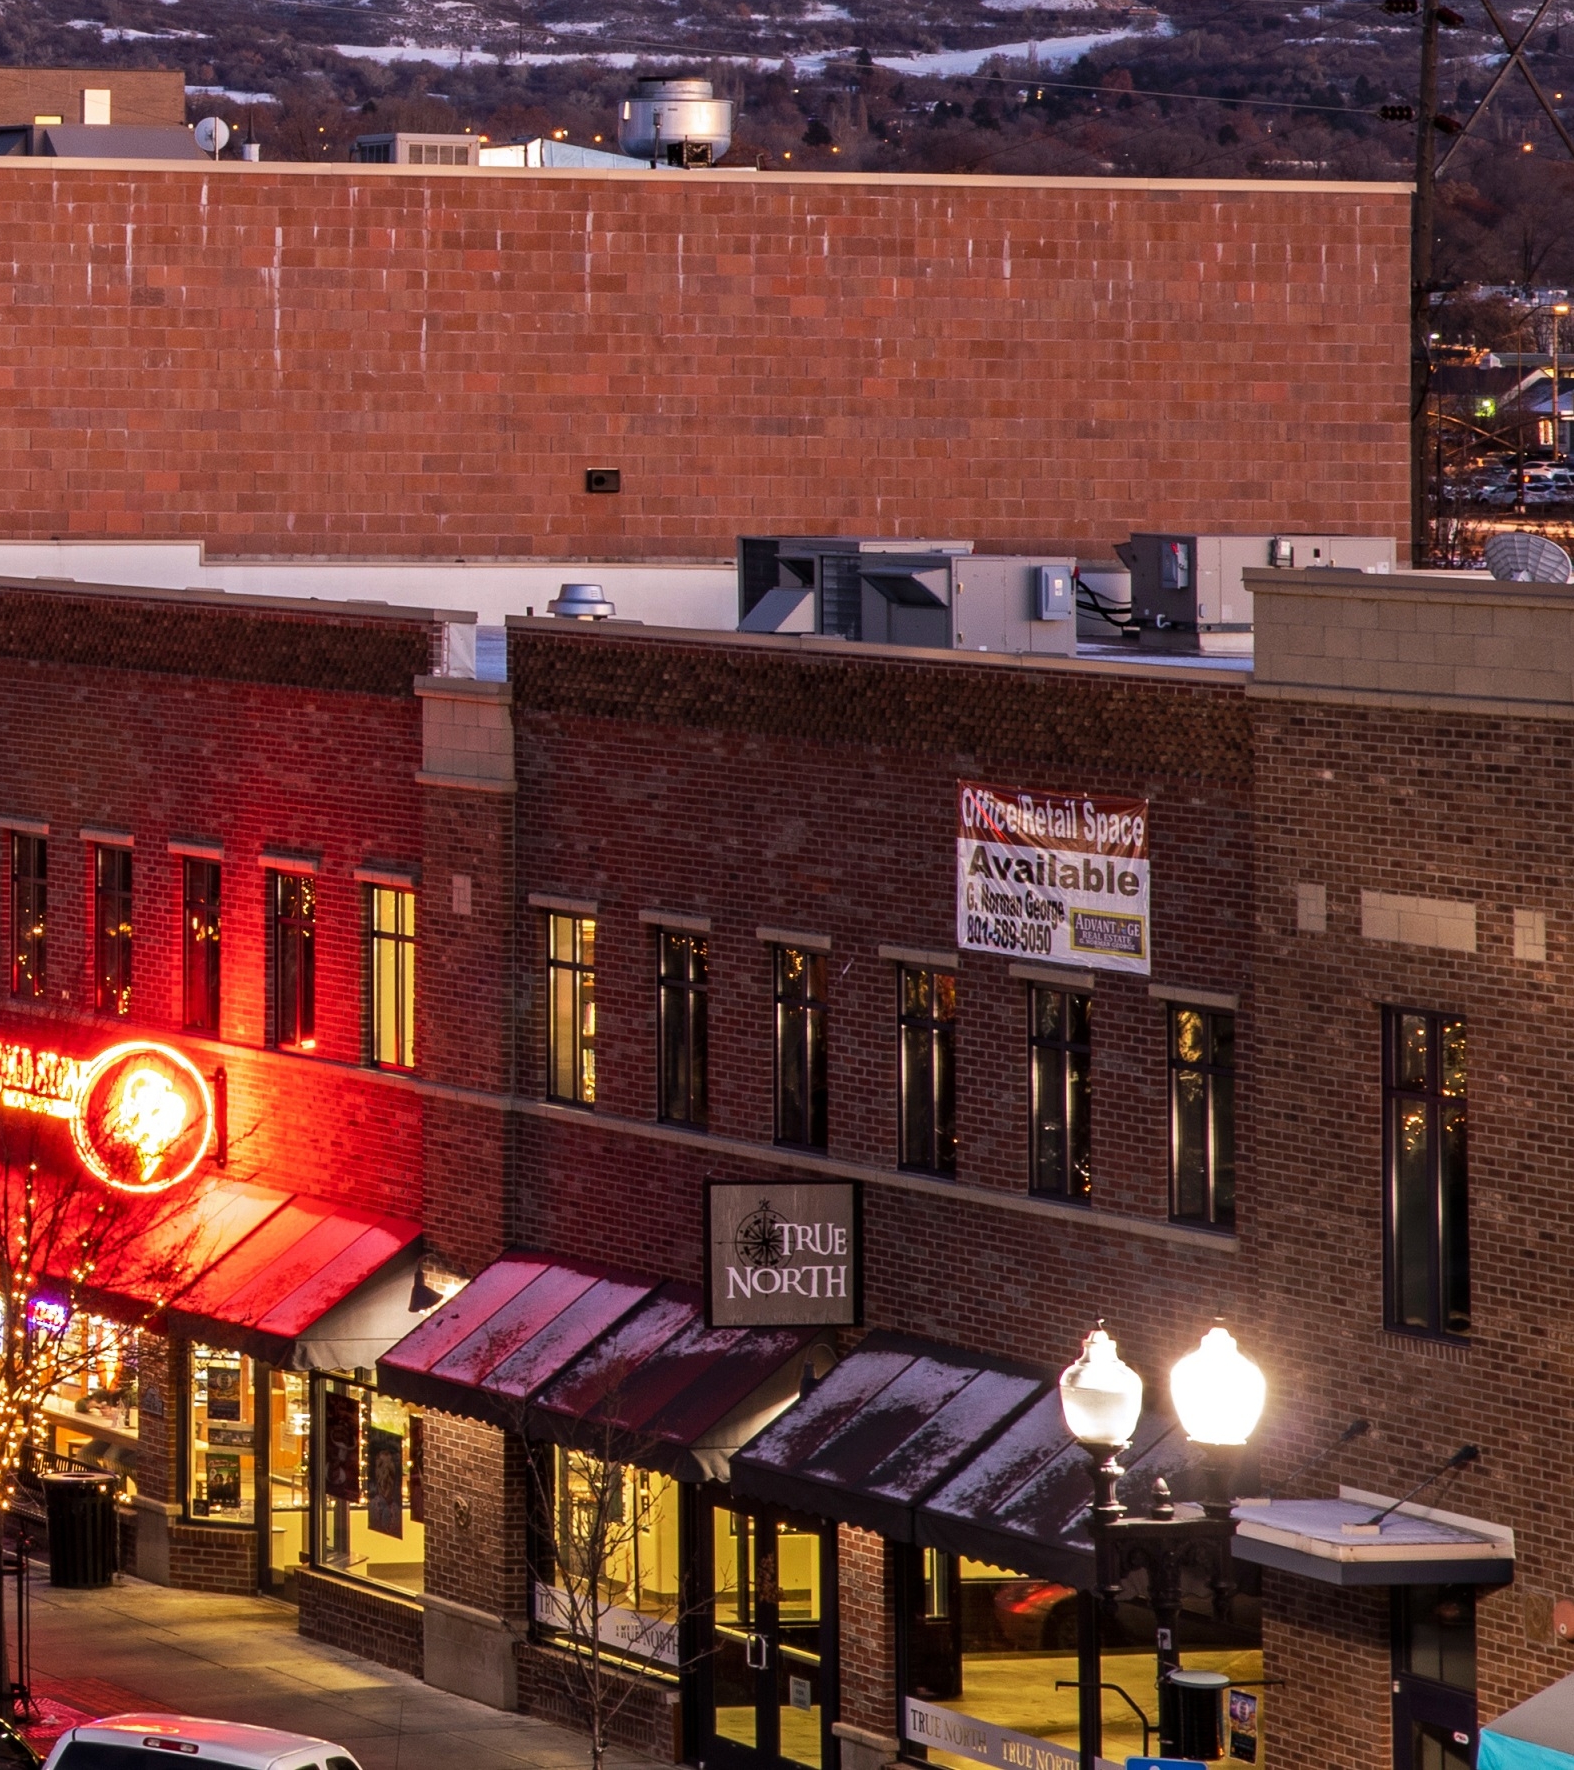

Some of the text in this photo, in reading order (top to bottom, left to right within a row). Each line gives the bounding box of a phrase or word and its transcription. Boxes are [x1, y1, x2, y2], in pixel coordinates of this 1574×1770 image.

[961, 787, 1145, 852] Office/Retail Space
[967, 845, 1140, 897] Available
[966, 882, 1065, 931] G. Norman George
[967, 914, 1052, 956] 801-589-5050
[1082, 931, 1133, 944] REAL ESTATE
[774, 1222, 848, 1256] TRUE
[725, 1265, 848, 1299] NORTH
[910, 1708, 942, 1739] TRUE
[944, 1719, 988, 1754] NORTH
[1001, 1737, 1034, 1767] TRUE
